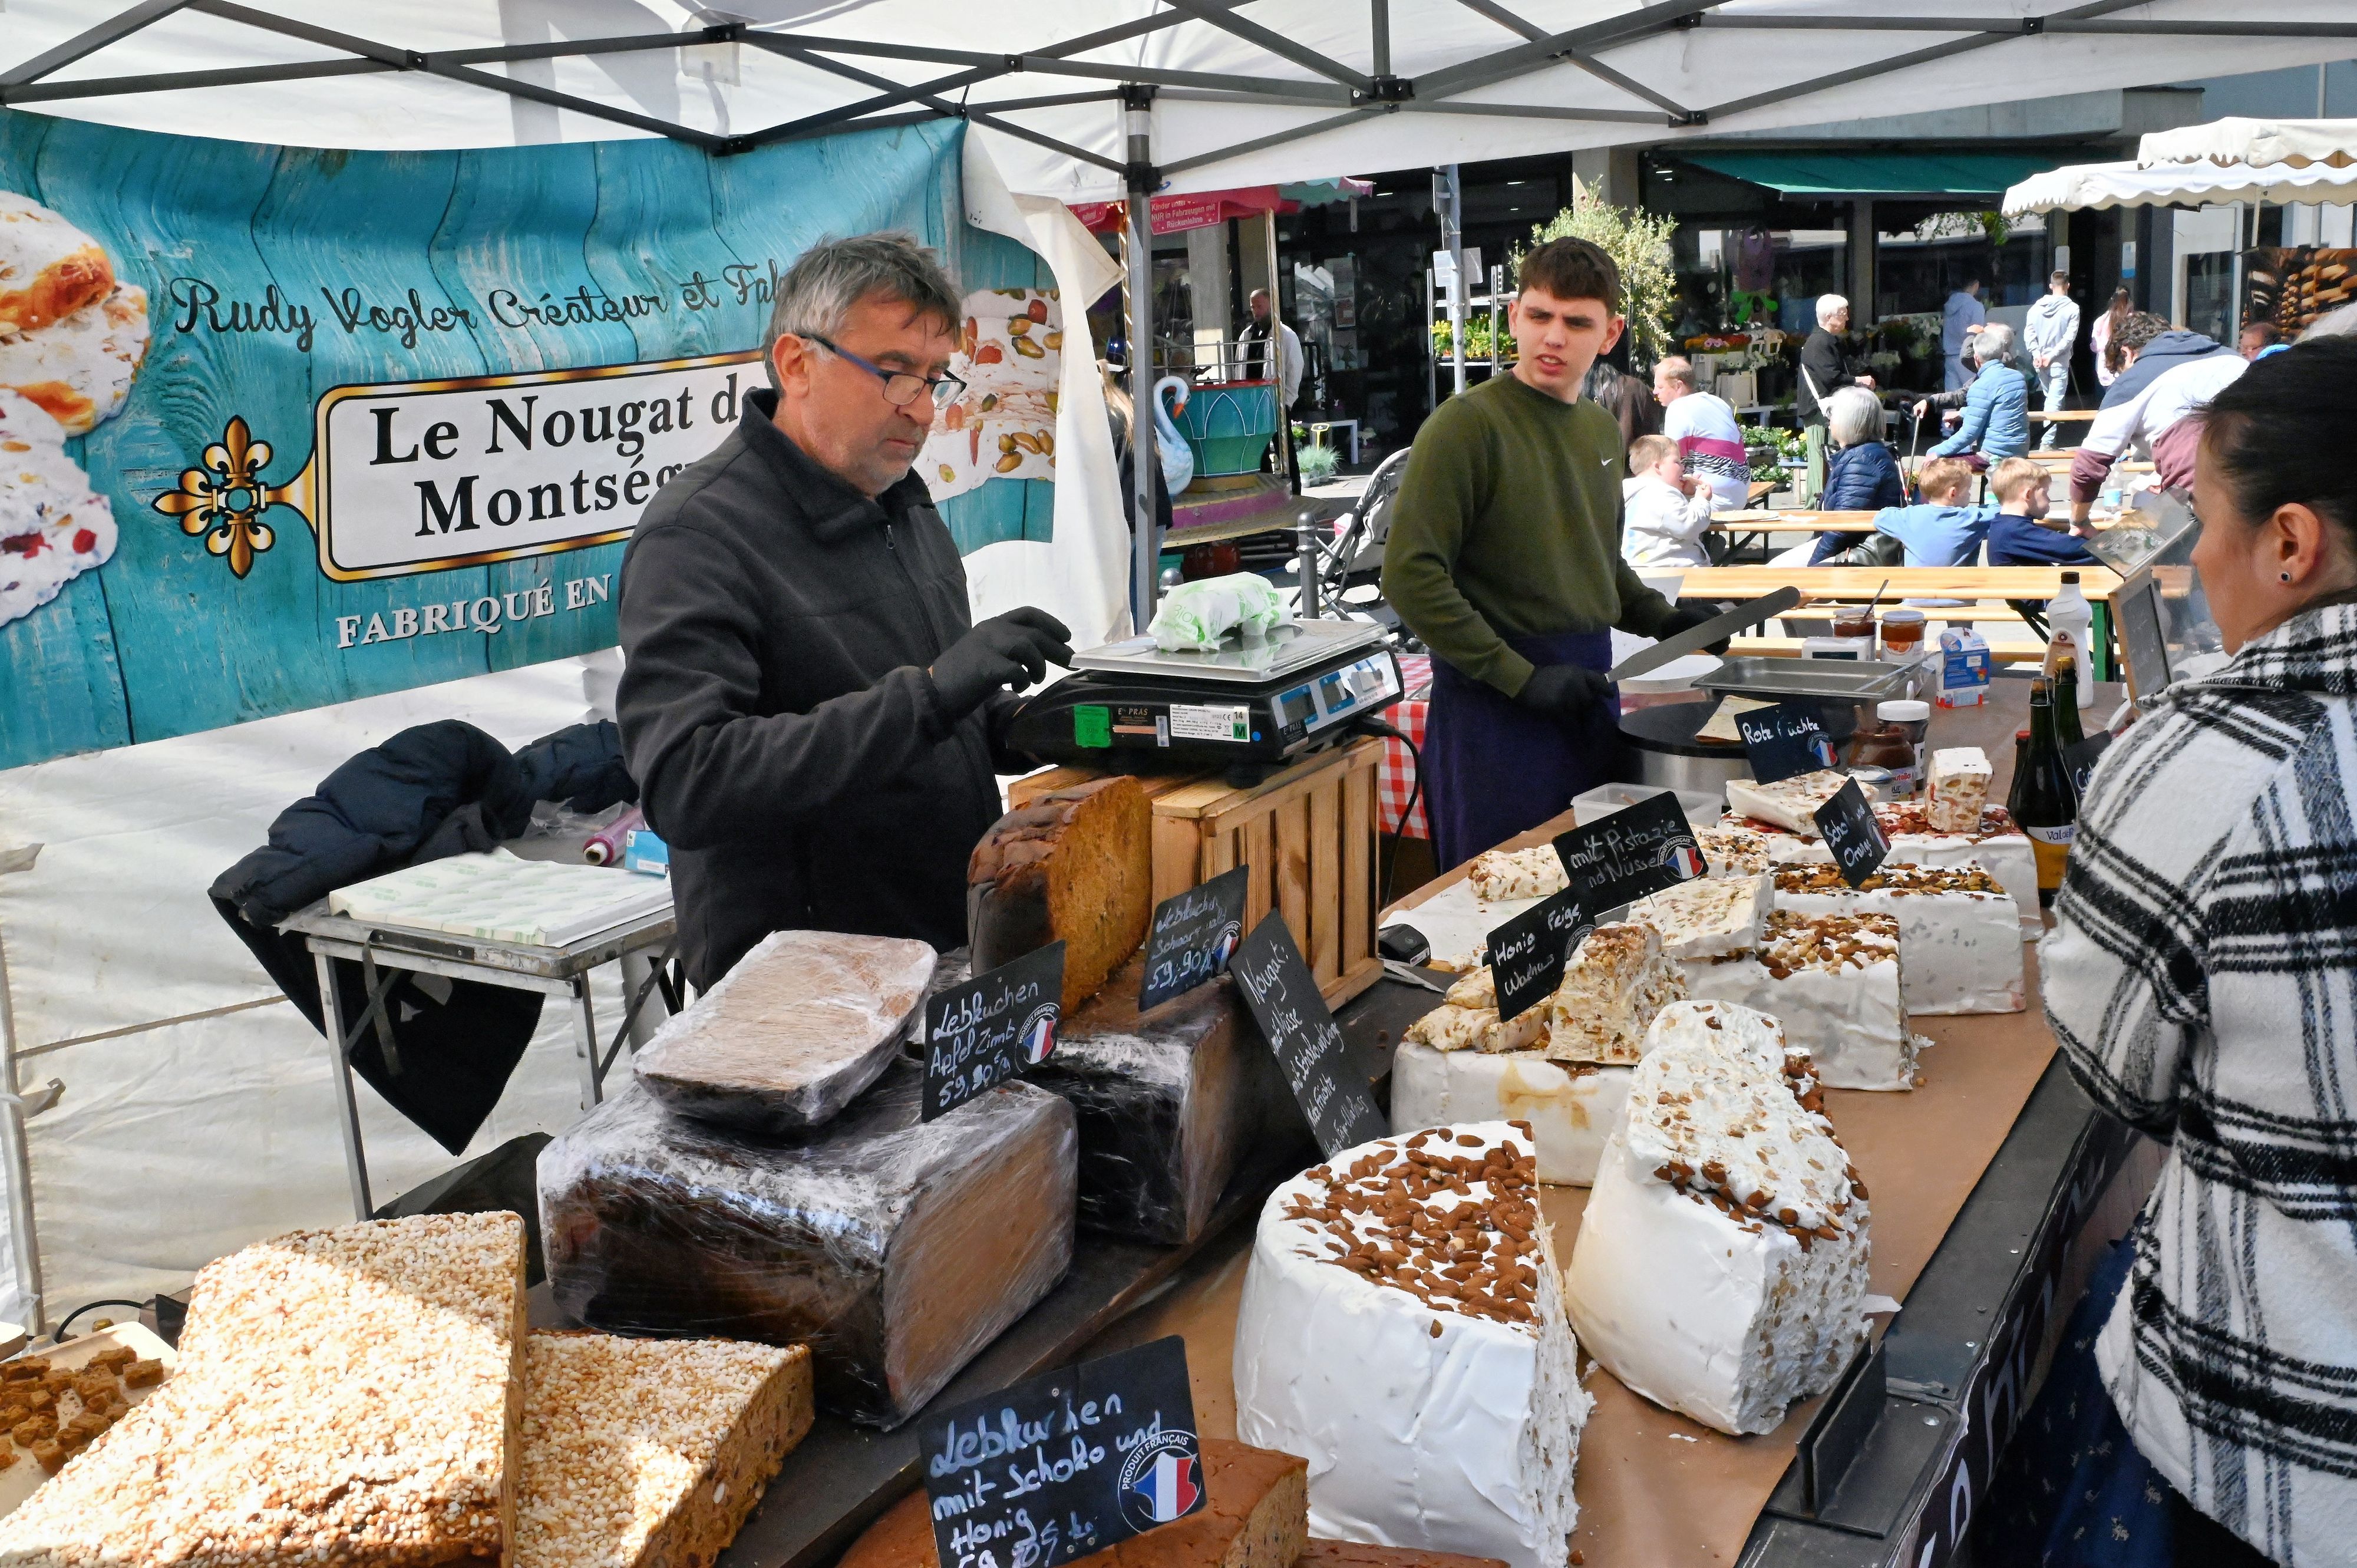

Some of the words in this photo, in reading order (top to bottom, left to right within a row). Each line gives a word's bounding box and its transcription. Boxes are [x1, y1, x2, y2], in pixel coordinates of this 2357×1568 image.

[1151, 203, 1170, 211] Kinder
[1151, 212, 1164, 222] NUR
[1173, 206, 1205, 217] Fahrzeugen
[1167, 217, 1203, 228] Rückenlehne
[170, 277, 317, 352] Rudy
[321, 285, 478, 349] Vogler
[488, 285, 668, 329] Créateur
[681, 272, 721, 309] et
[722, 258, 784, 305] Fab
[368, 406, 460, 466] Le
[486, 386, 694, 458] Nougat
[711, 372, 739, 425] d
[335, 578, 555, 649] FABRIQUÉ
[565, 573, 612, 610] EN
[1234, 711, 1243, 719] 14
[1235, 725, 1246, 737] M
[1742, 722, 1774, 745] Rote
[1570, 834, 1605, 869] mit
[1603, 820, 1682, 864] Pistazie
[1605, 855, 1661, 882] Nüsse
[1495, 932, 1536, 967] Honig
[932, 982, 1039, 1042] Lebkuchen
[929, 1028, 976, 1078] Apfel
[975, 1018, 1016, 1055] Zimt
[933, 1470, 996, 1521] mit
[1003, 1434, 1105, 1500] Schoko
[1116, 1409, 1160, 1453] und
[1121, 1447, 1146, 1490] PRODUIT
[1144, 1434, 1189, 1452] FRANÇAIS
[950, 1507, 1037, 1555] Honig
